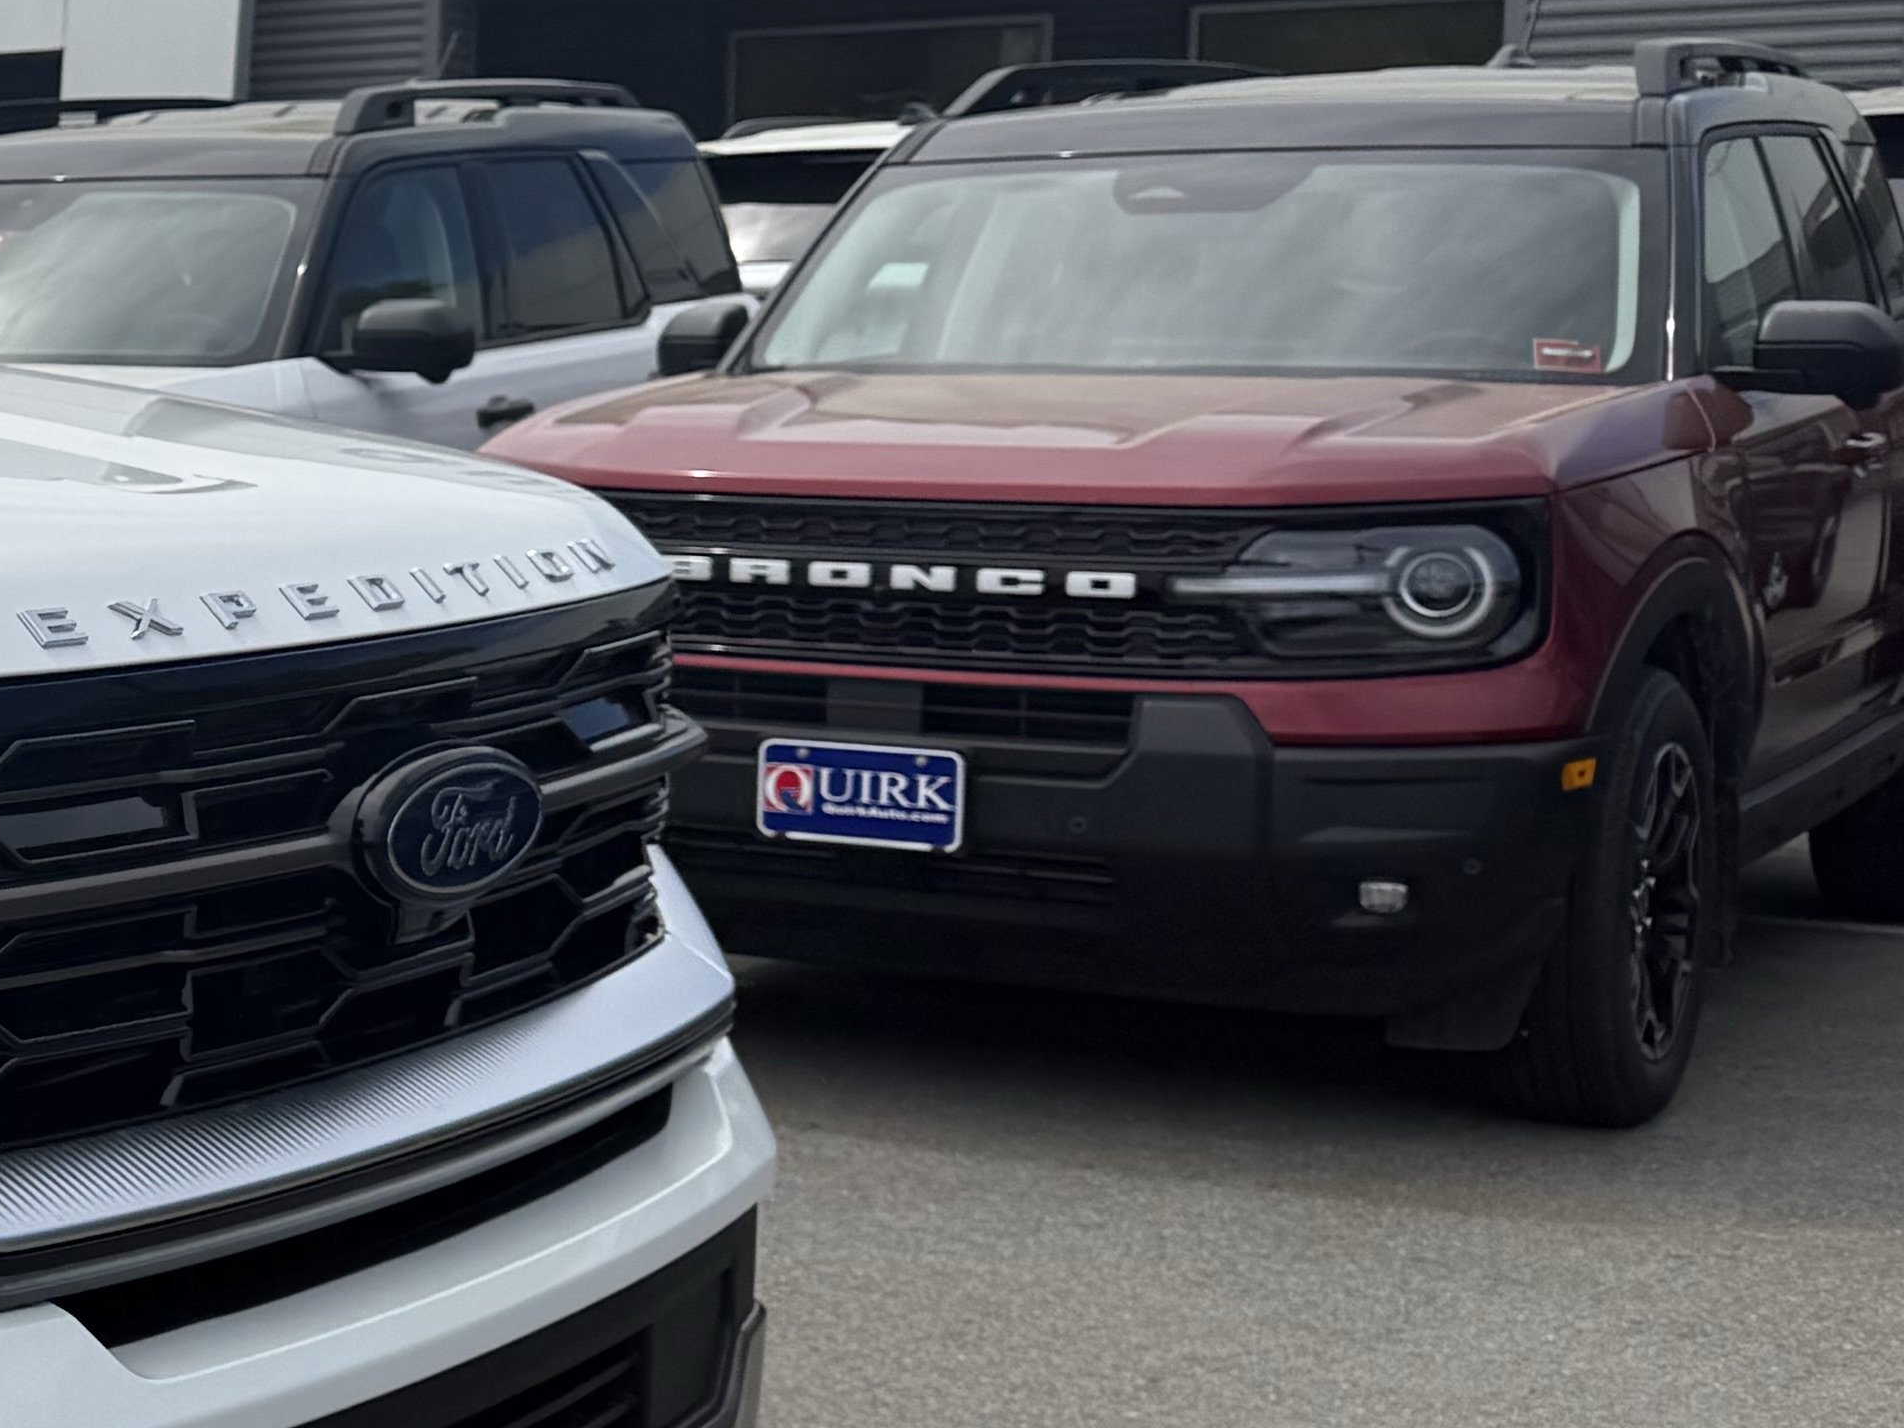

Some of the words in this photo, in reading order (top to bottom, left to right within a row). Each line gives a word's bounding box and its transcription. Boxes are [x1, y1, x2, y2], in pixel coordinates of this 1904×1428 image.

[16, 538, 616, 649] EXPEDITION
[669, 555, 1136, 599] BRONCO
[764, 764, 954, 813] QUIRK
[418, 780, 518, 877] Ford
